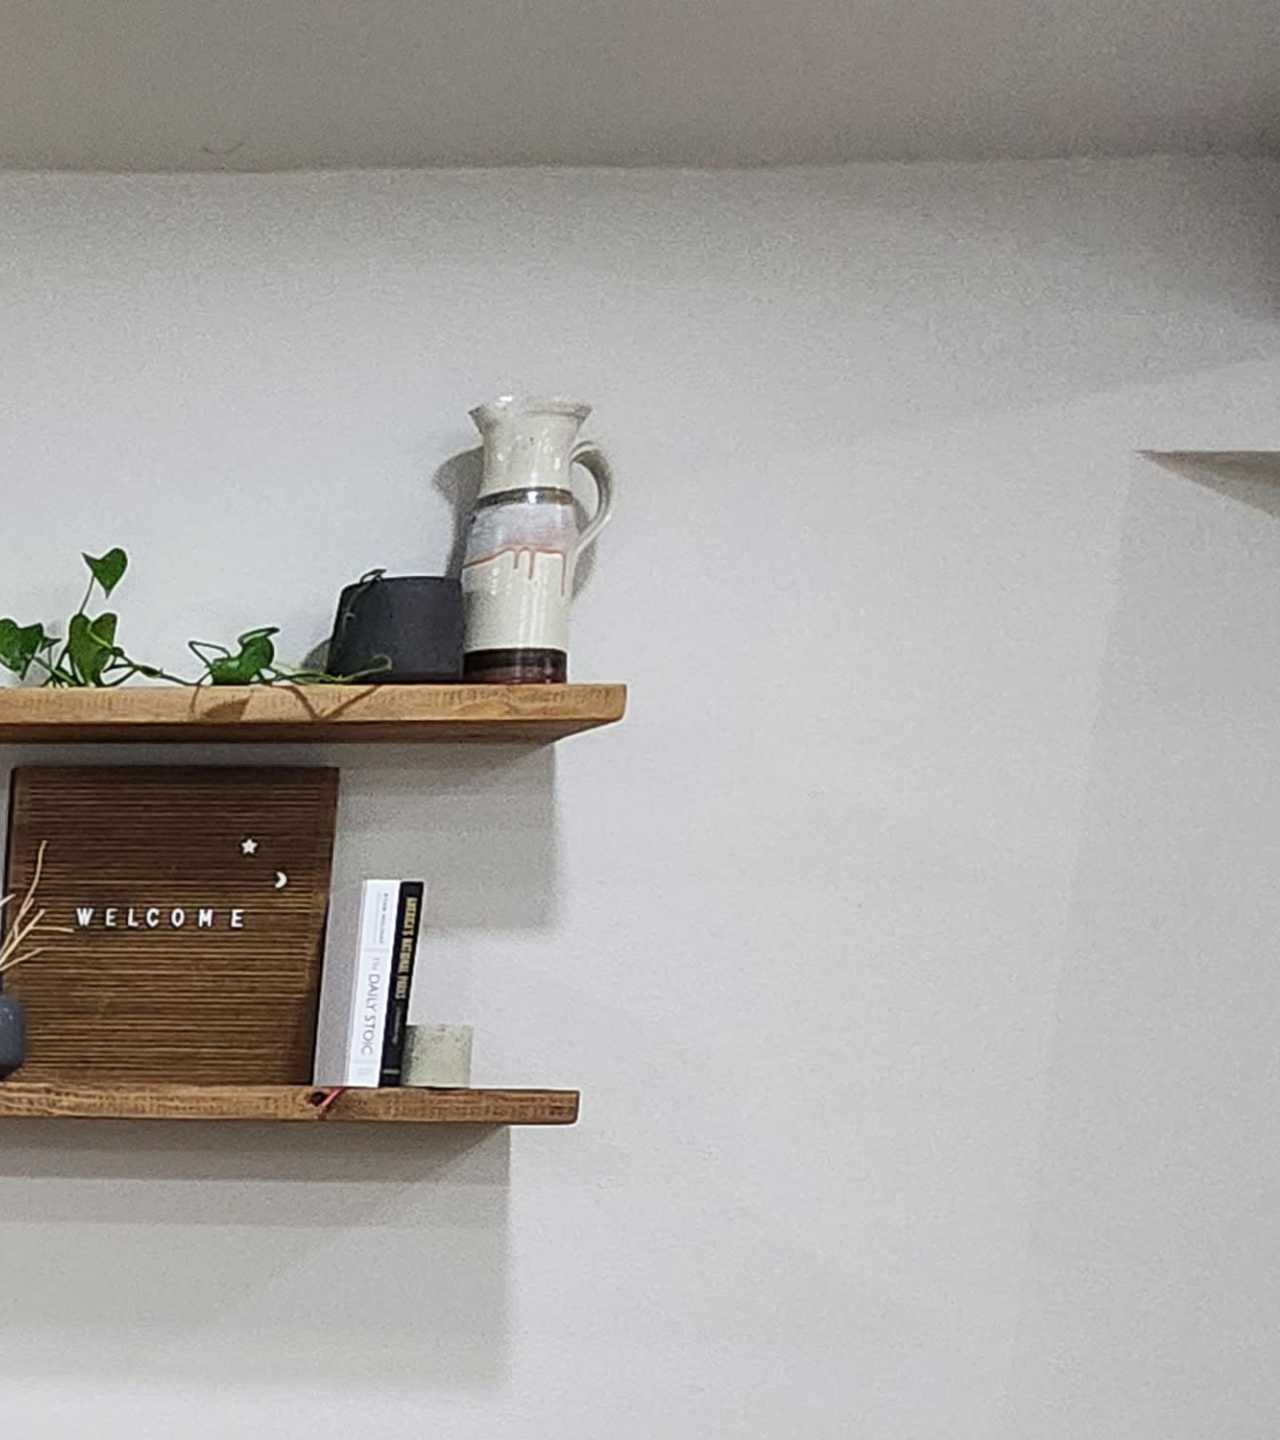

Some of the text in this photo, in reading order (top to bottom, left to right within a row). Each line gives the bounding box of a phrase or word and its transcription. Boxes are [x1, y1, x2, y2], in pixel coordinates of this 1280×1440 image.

[76, 907, 244, 928] WELCOME
[366, 973, 381, 1013] DAILY
[361, 1015, 376, 1056] STOIC
